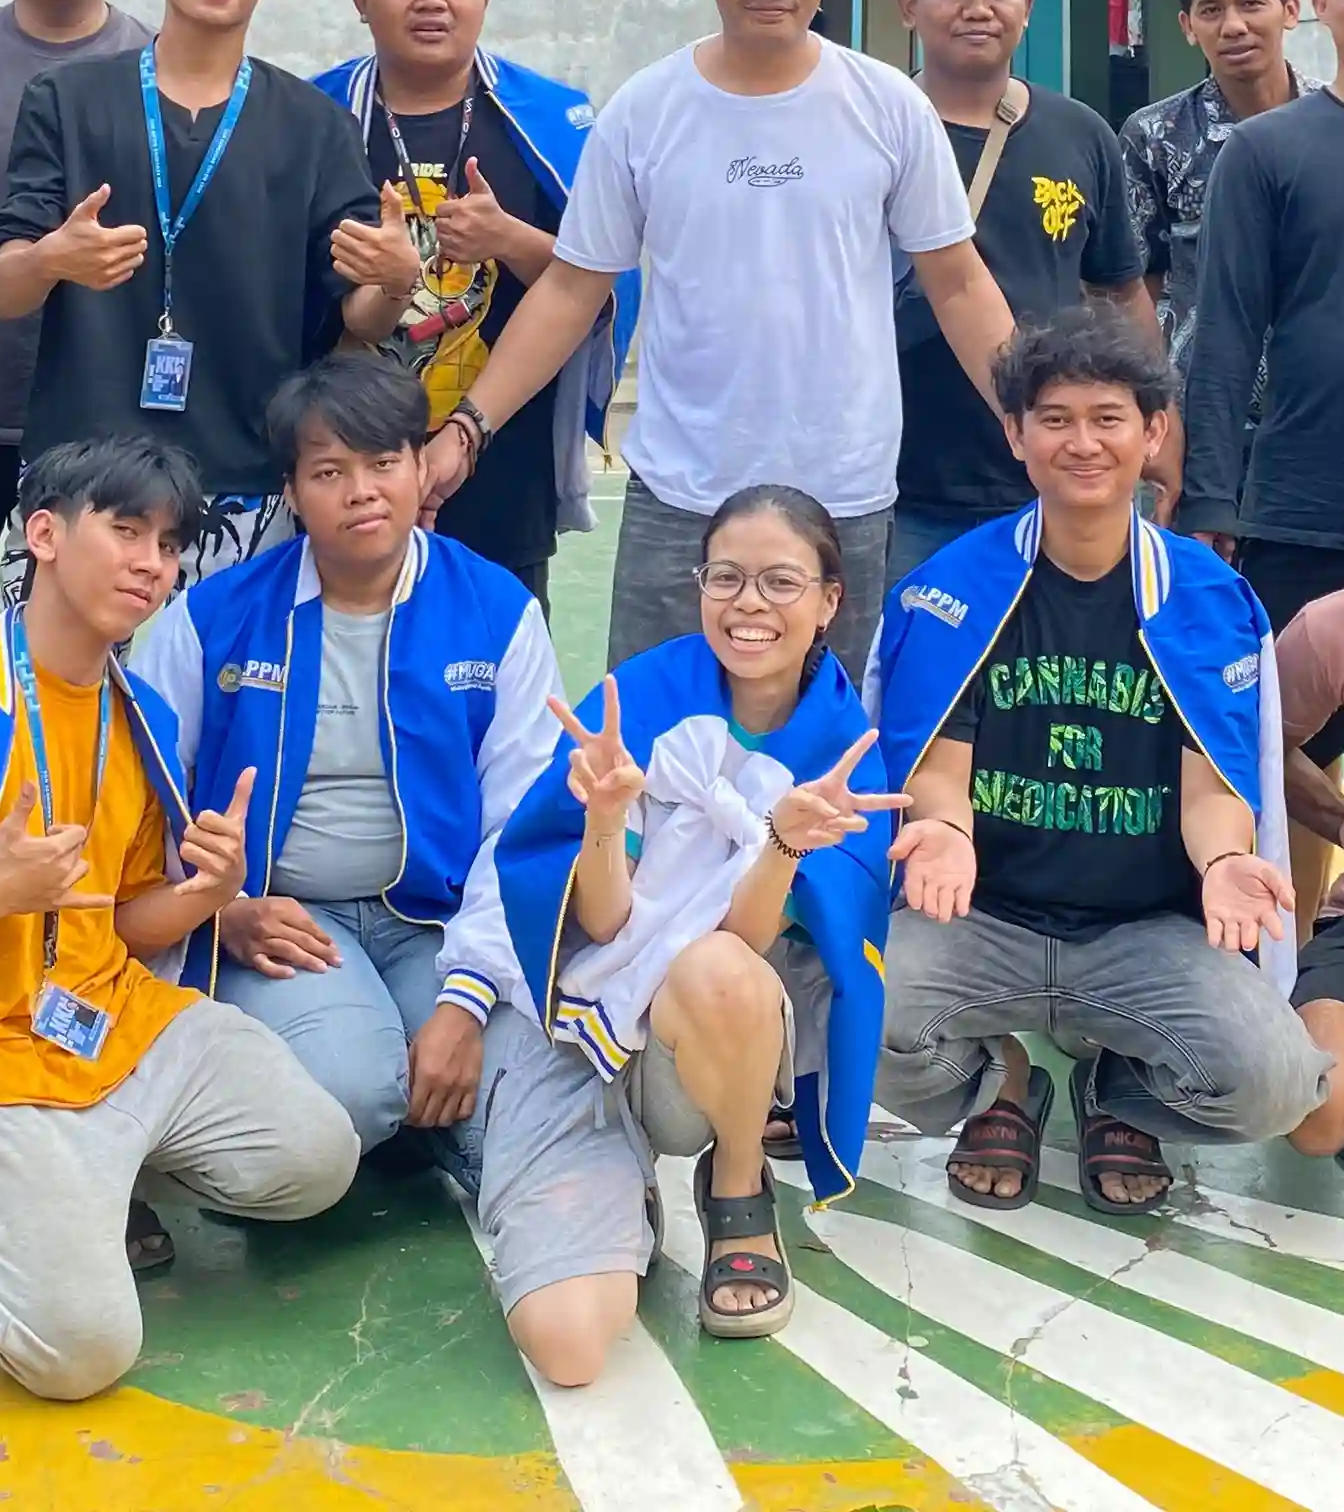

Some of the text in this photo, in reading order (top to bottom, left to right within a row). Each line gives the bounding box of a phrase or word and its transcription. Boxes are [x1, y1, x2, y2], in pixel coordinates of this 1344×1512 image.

[726, 156, 804, 185] Nevada
[1031, 176, 1086, 208] BACK
[917, 584, 969, 621] LPPM
[988, 655, 1166, 724] CANNABIS
[1047, 723, 1104, 771] FOR
[972, 769, 1166, 836] MEDICATION
